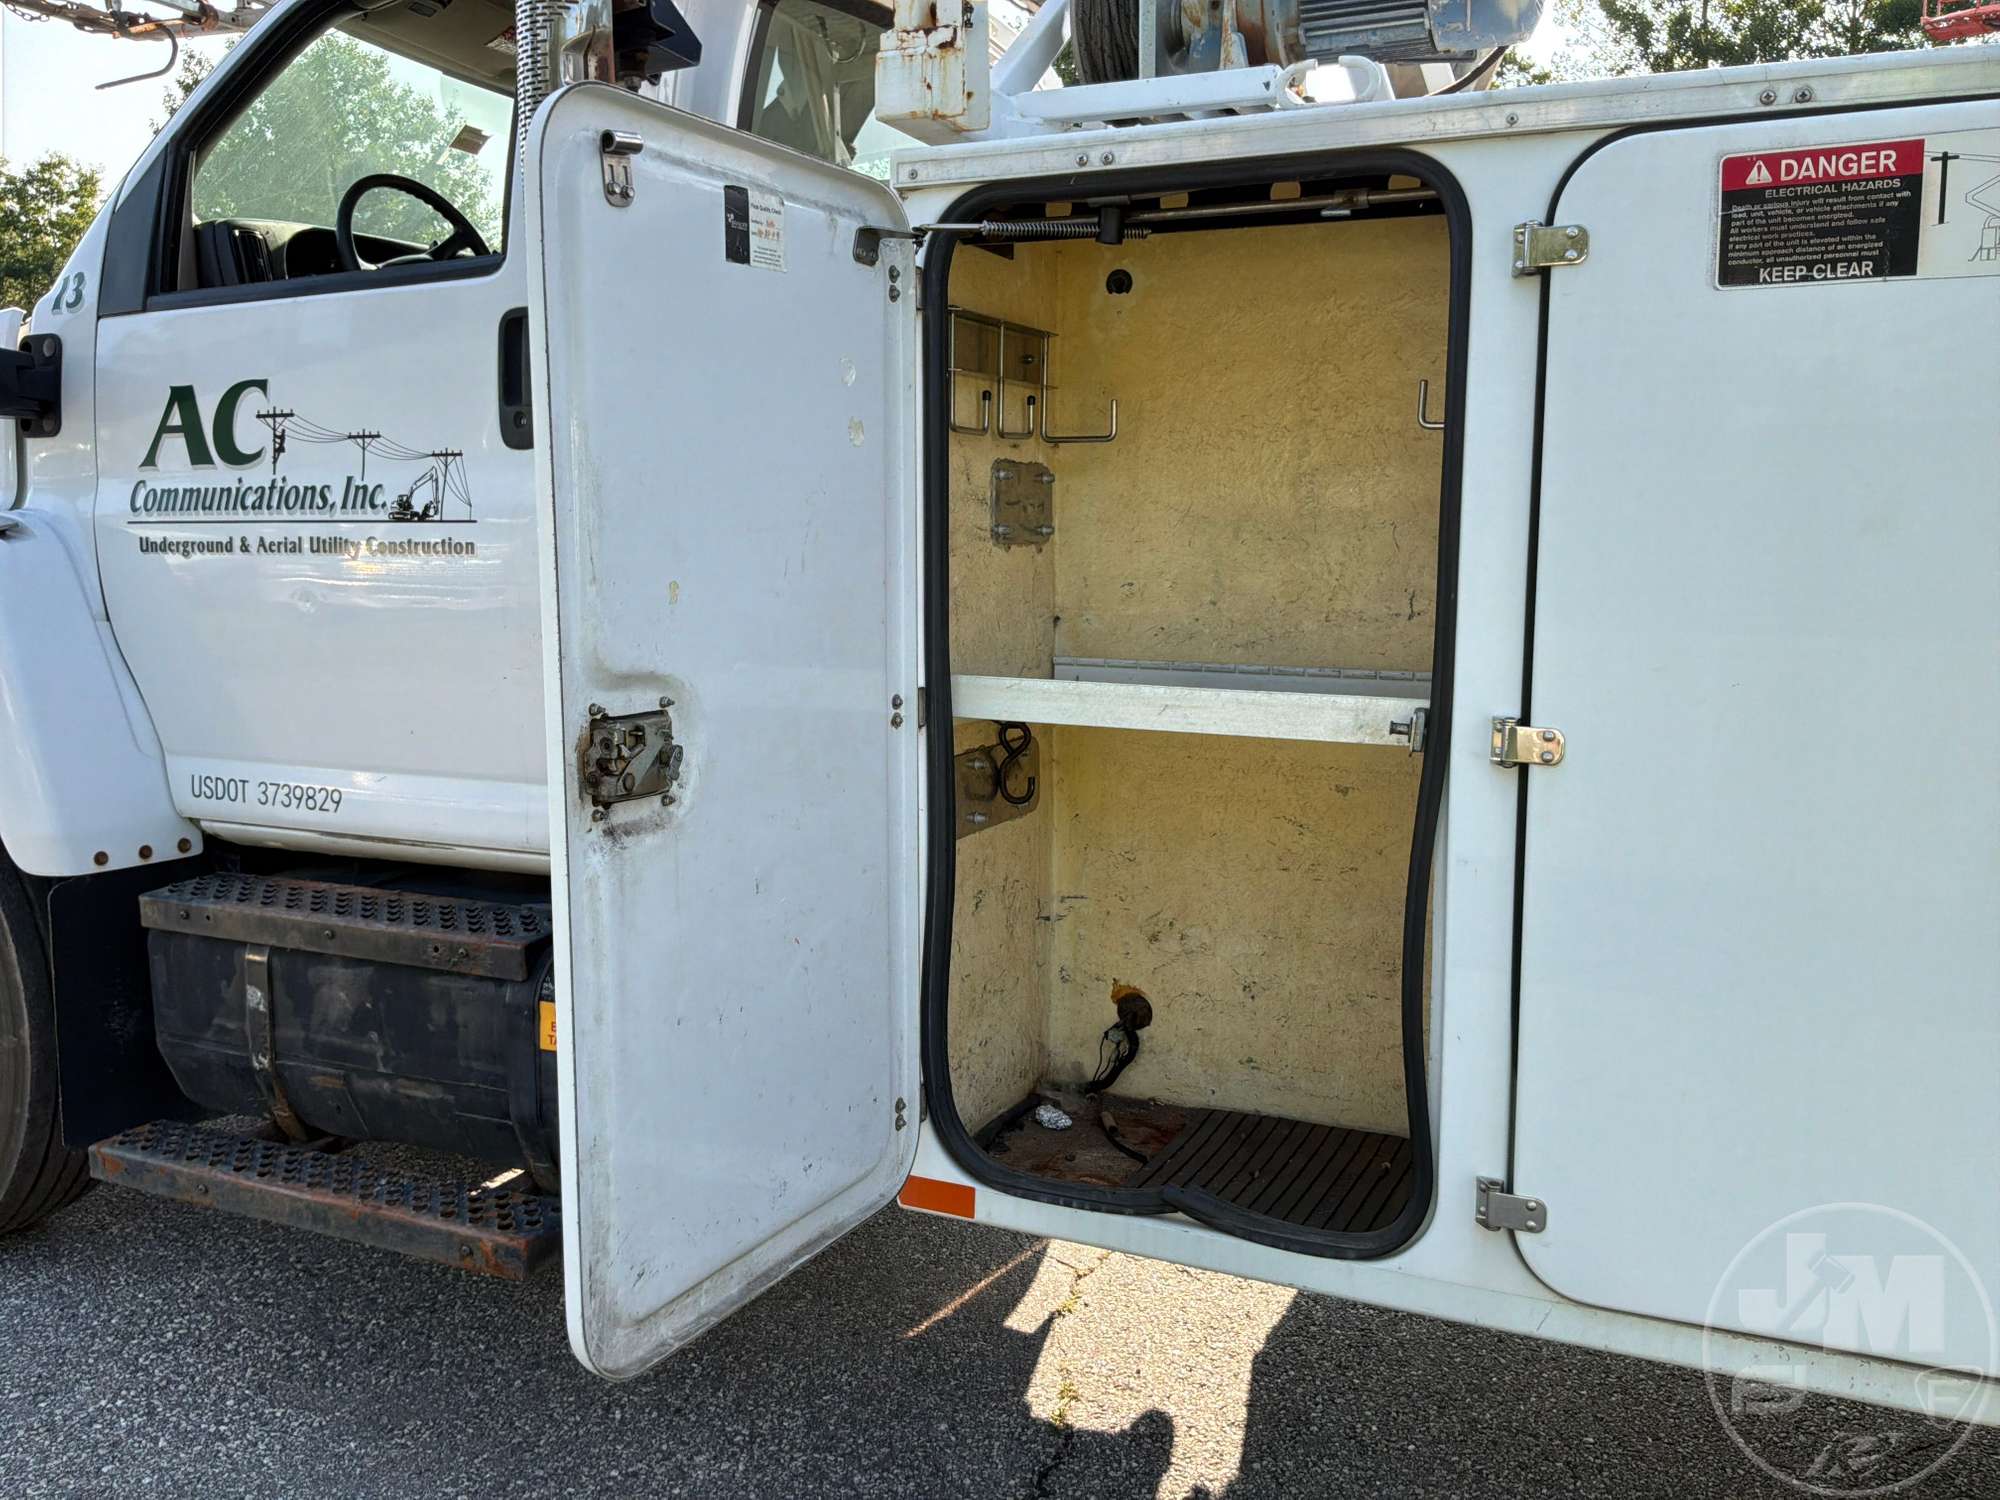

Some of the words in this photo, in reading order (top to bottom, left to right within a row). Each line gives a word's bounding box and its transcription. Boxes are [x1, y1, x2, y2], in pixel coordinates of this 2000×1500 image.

[1780, 150, 1897, 181] DANGER
[1765, 184, 1838, 198] ELECTRICAL
[1842, 178, 1901, 192] HAZARDS
[1790, 200, 1810, 208] injury
[1826, 196, 1847, 204] result
[1896, 190, 1911, 198] with
[1805, 205, 1830, 213] vehicle
[1832, 201, 1877, 211] attachments
[1885, 200, 1899, 208] any
[1731, 219, 1745, 227] part
[1768, 216, 1781, 224] unit
[1783, 214, 1815, 222] becomes
[1740, 225, 1768, 233] workers
[1769, 223, 1788, 231] must
[1789, 220, 1829, 230] understand
[1846, 218, 1868, 226] follow
[1870, 216, 1886, 224] safe
[1729, 233, 1760, 242] electrical
[1762, 232, 1779, 240] work
[1809, 236, 1840, 244] elevated
[1841, 234, 1863, 242] within
[1776, 253, 1822, 263] unauthorized
[1823, 250, 1859, 260] personnel
[1795, 245, 1826, 253] distance
[1847, 241, 1883, 250] energized
[1759, 264, 1808, 283] KEEP
[1812, 260, 1874, 279] CLEAR
[52, 272, 87, 315] 13
[137, 378, 270, 472] AC
[129, 477, 337, 516] Communications,
[340, 475, 388, 514] Inc.
[139, 536, 234, 555] Underground
[239, 536, 250, 553] &
[256, 535, 303, 554] Aerial
[308, 535, 361, 559] Utility
[366, 536, 476, 556] Construction
[191, 774, 249, 803] USDOT
[257, 781, 343, 813] 3739829
